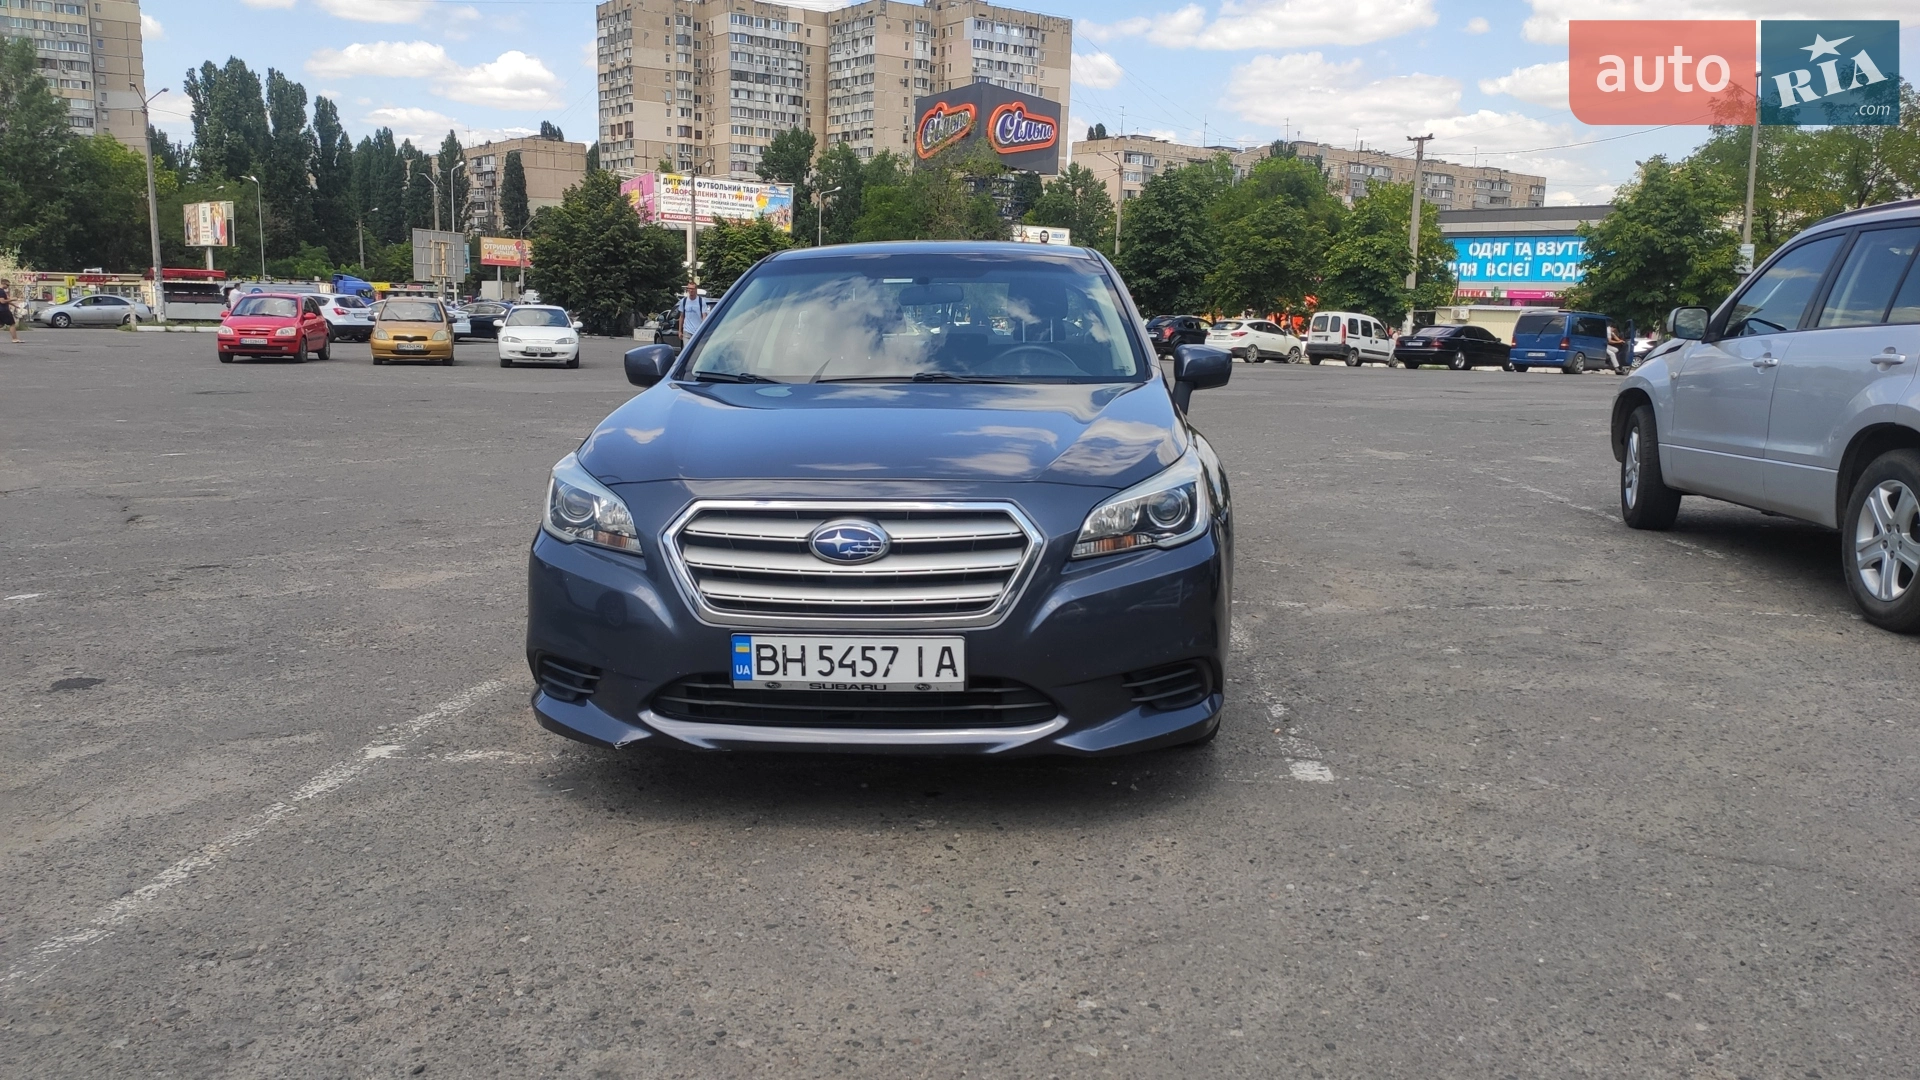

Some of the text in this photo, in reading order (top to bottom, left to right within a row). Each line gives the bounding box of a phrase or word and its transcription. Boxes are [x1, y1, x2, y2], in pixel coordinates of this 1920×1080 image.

[922, 110, 971, 150] Сільпо
[996, 110, 1054, 145] Сільпо
[663, 177, 694, 187] ДИТЯЧИ
[696, 181, 742, 192] ФУТБОЛЬНИЙ
[742, 186, 760, 194] ТАБІР
[665, 187, 718, 198] ОЗДОРОЛЕННЯ
[728, 193, 753, 202] ТУРНІРИ
[484, 243, 516, 251] ОТРИМУЙ
[1468, 240, 1586, 259] ОДЯГ ТА ВЗУТТ
[1486, 256, 1532, 277] ВСІЄЇ
[1457, 290, 1487, 298] ПТЕКА
[755, 643, 959, 678] BH 5457 IA
[735, 664, 751, 676] UA
[809, 682, 887, 691] SUBARU
